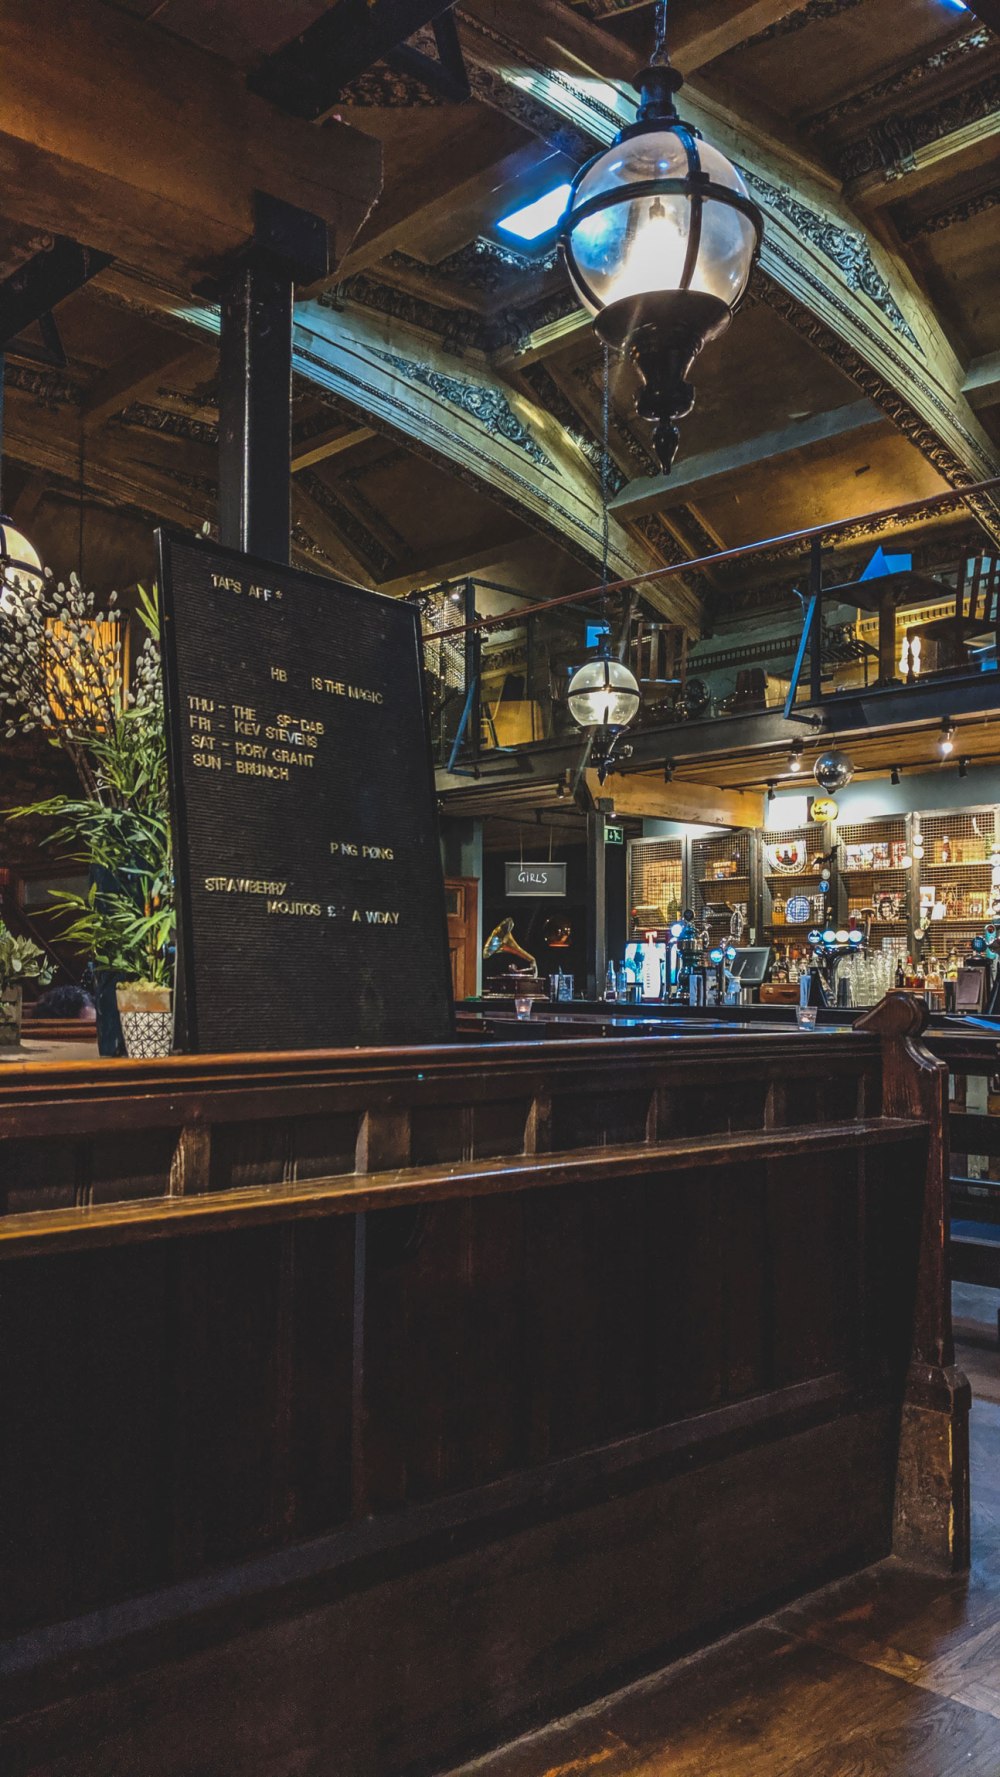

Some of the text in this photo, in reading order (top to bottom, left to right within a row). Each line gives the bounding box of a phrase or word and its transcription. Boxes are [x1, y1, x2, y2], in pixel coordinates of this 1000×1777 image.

[211, 574, 272, 601] TAPS AFF
[271, 667, 383, 704] HB IS THE MAGIC
[187, 696, 214, 713] THU
[232, 705, 257, 721] THE
[189, 715, 212, 732] FRI
[234, 720, 261, 736] KEV
[265, 726, 318, 748] STEVENS
[191, 734, 216, 750] SAT
[235, 742, 268, 759] RORY
[272, 749, 315, 768] GRANT
[193, 753, 222, 771] SUN
[236, 760, 289, 781] BRUNCH
[205, 878, 287, 895] STRAWBERRY
[518, 872, 548, 884] GIRLS
[266, 901, 321, 916] MOJITOS
